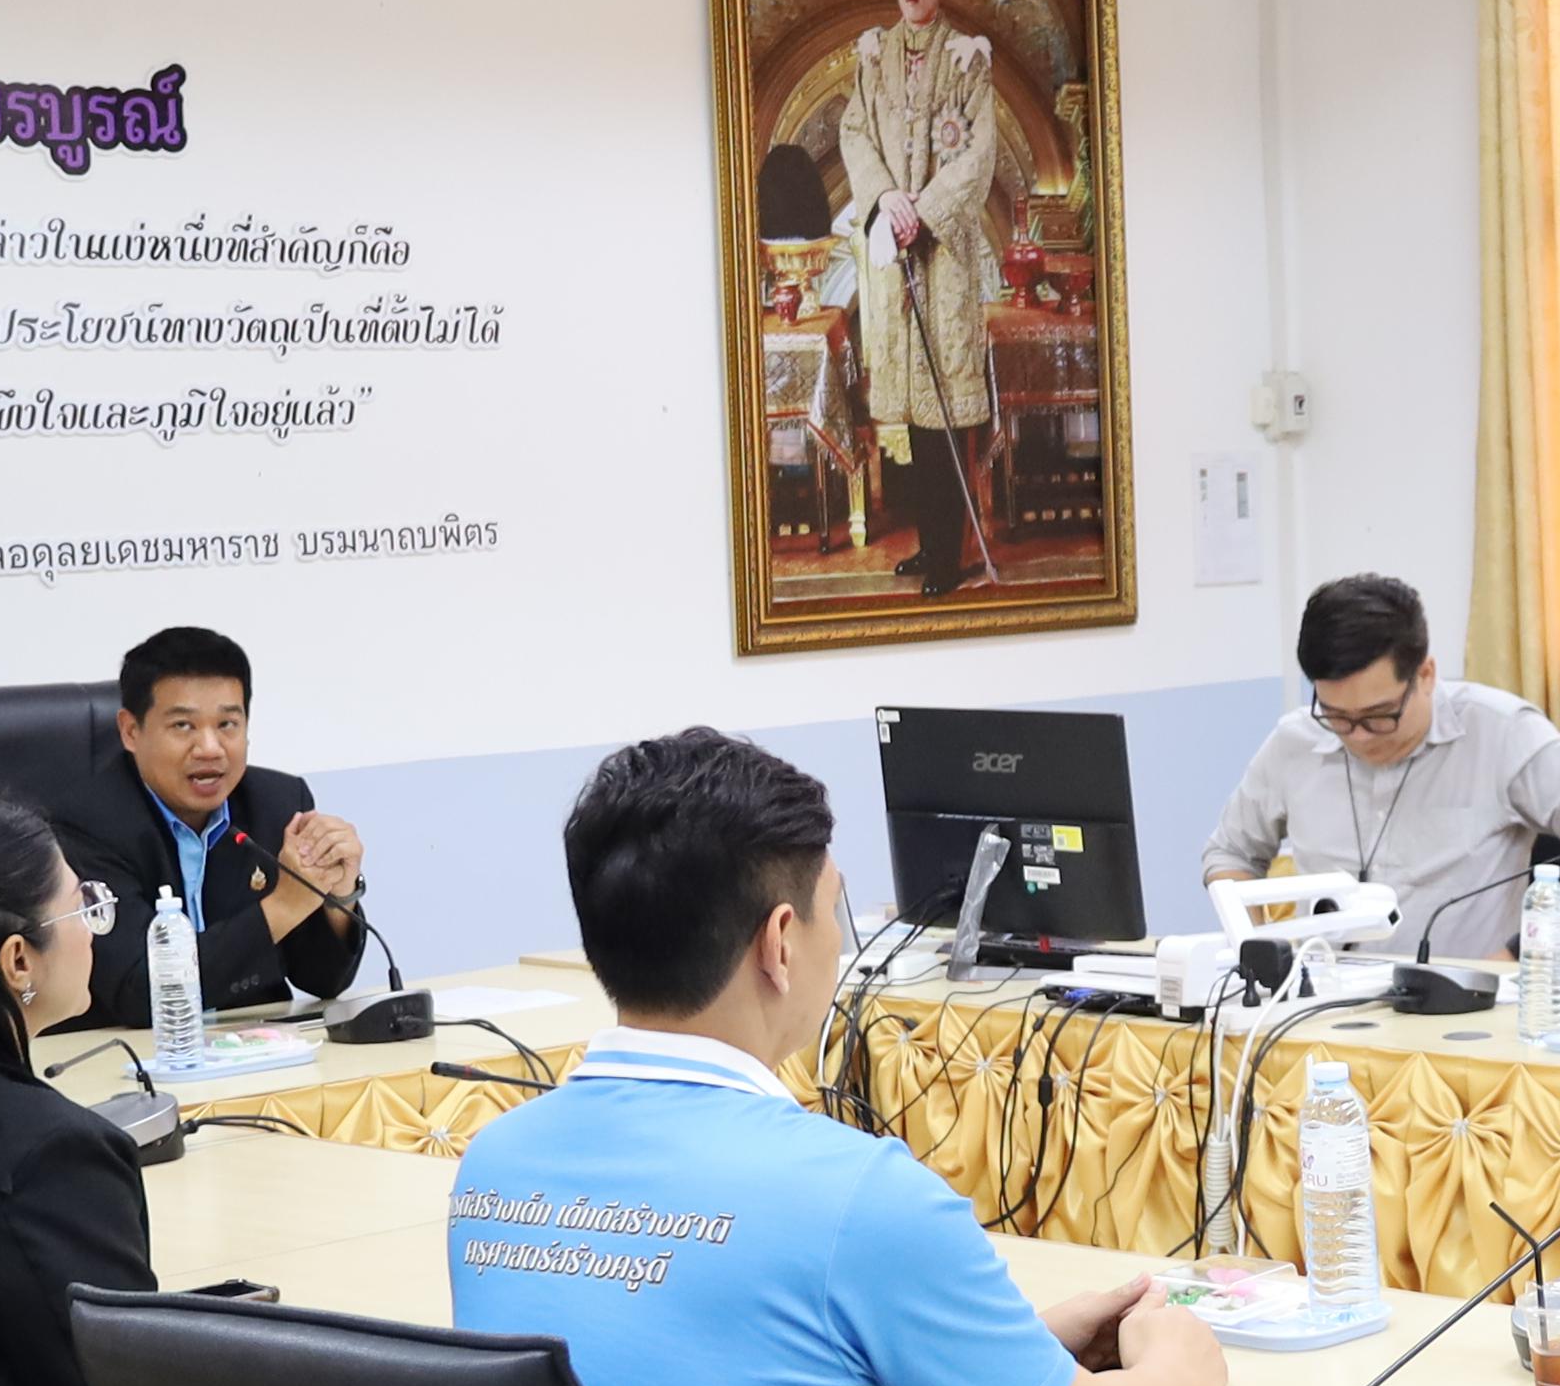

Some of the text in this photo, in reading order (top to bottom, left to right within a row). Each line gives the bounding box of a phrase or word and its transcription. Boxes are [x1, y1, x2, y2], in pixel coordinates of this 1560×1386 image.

[298, 513, 498, 557] บรมนาถบพิตร
[972, 751, 1024, 774] acer
[448, 1187, 736, 1244] รูดีสร้างเด็ก เด็กดีสร้างชาติ
[463, 1239, 673, 1293] ครุศาสตร์สร้างครูดี
